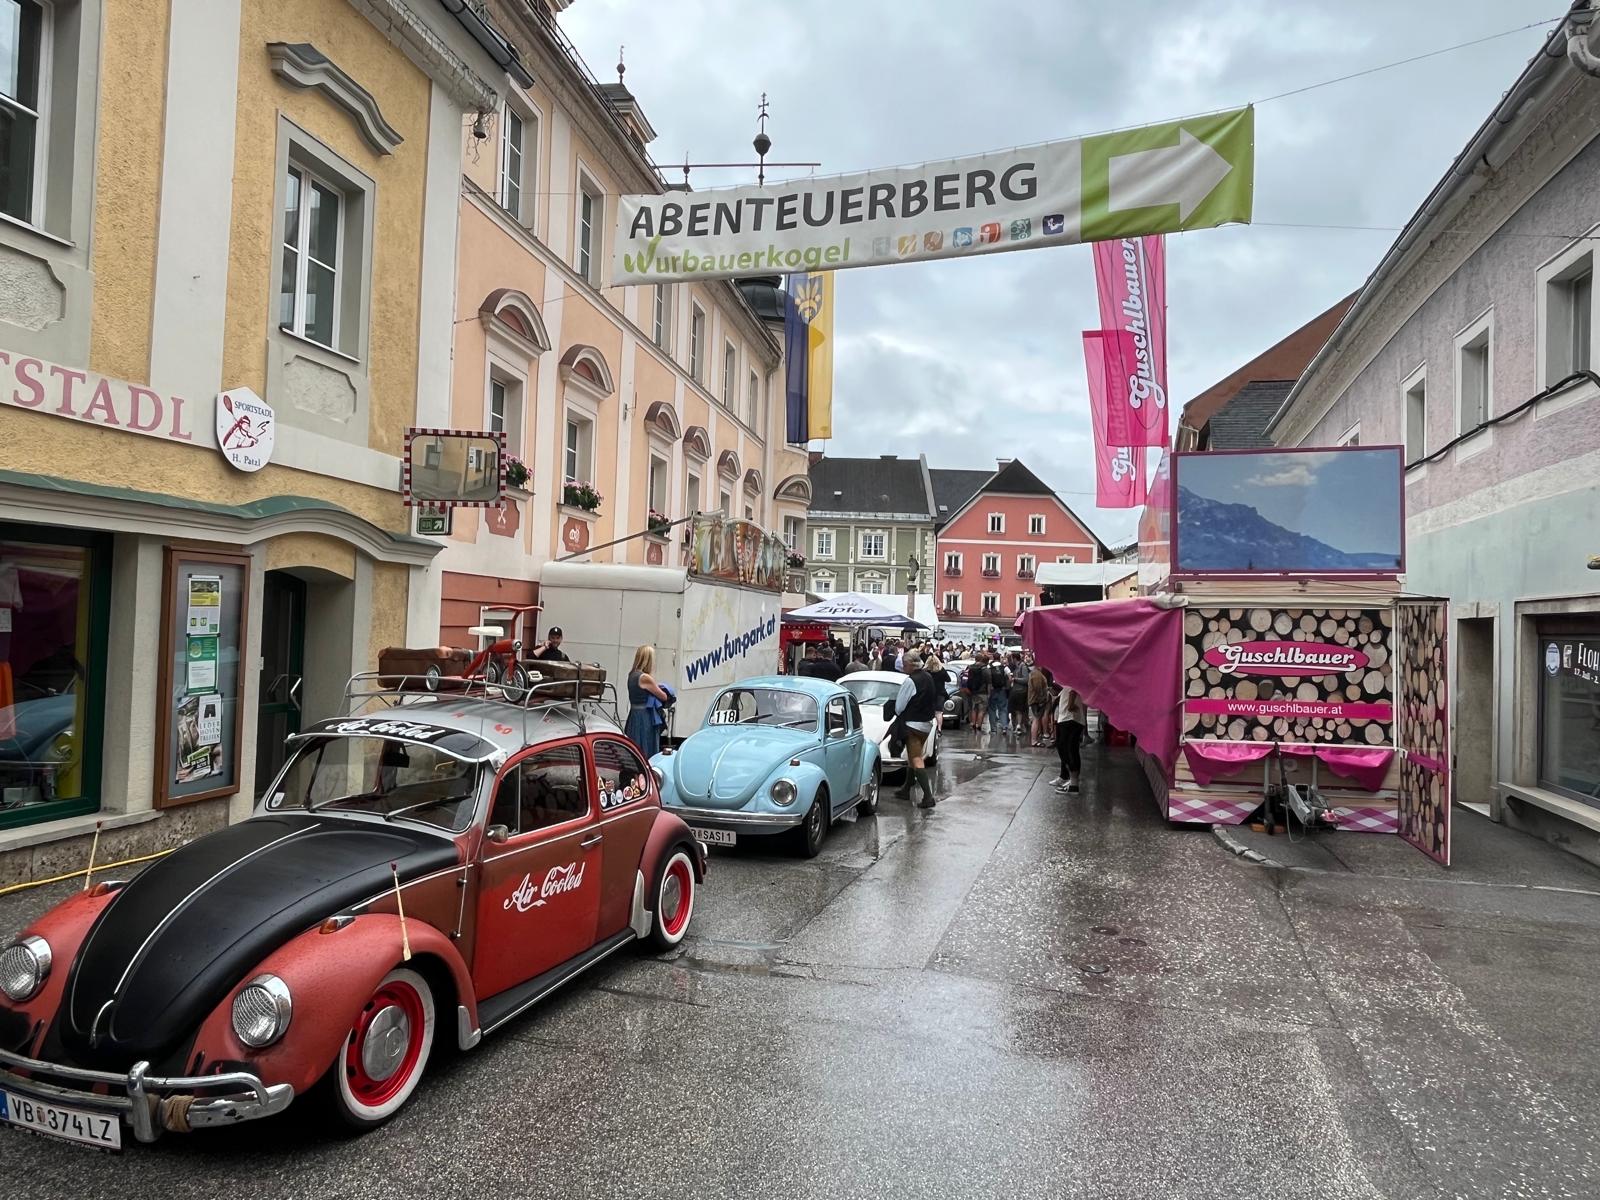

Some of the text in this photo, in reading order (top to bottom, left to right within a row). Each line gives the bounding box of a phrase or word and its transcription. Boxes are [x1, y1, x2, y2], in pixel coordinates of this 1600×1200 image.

[628, 162, 1038, 240] ABENTEUERBERG
[623, 233, 851, 274] Wurbauerkogel
[1121, 237, 1166, 409] Guschlbauer
[0, 352, 193, 441] STADL
[234, 400, 273, 418] SPORTSTADL
[232, 453, 241, 463] H.
[815, 605, 873, 615] Zipfer
[1218, 644, 1357, 674] Guschlbauer
[716, 710, 736, 724] 118
[1227, 702, 1343, 716] www.guschlbauer.at
[503, 861, 586, 913] Air Cooled
[11, 1097, 34, 1123] VB
